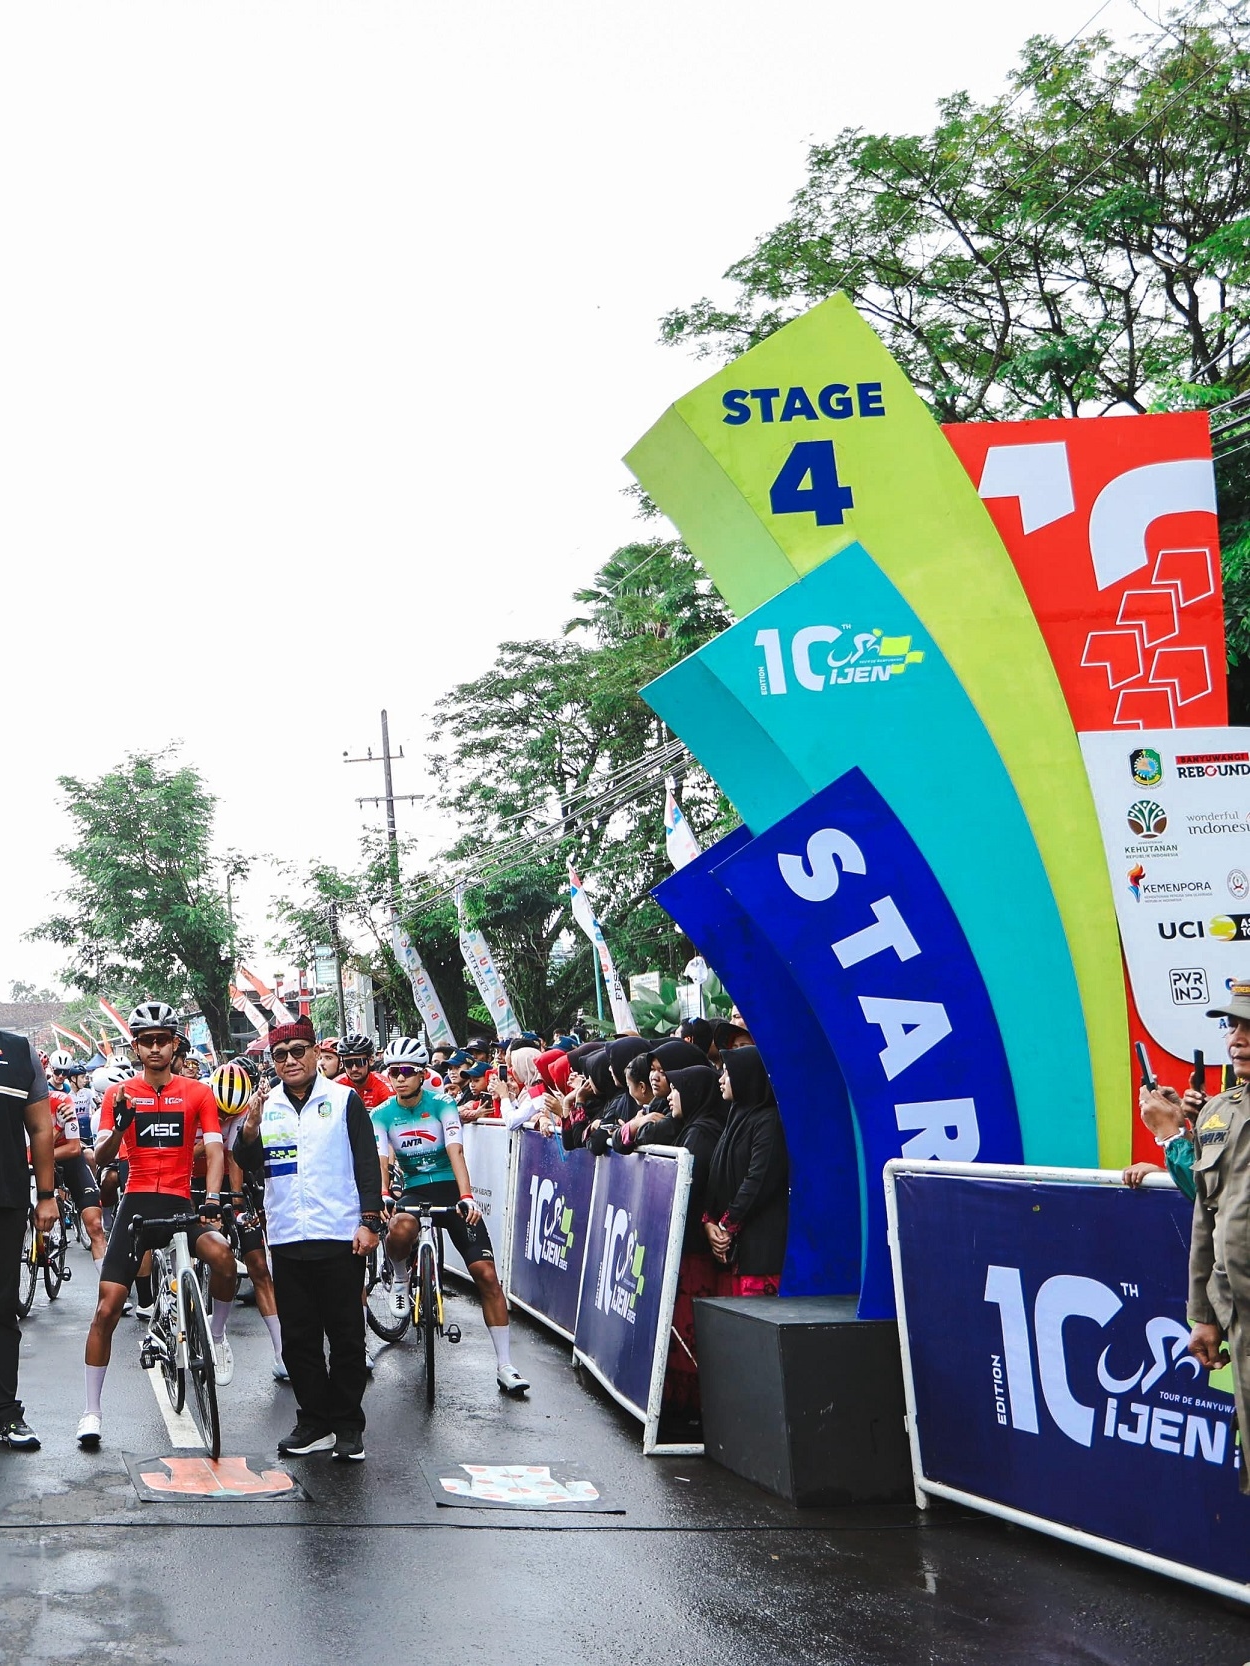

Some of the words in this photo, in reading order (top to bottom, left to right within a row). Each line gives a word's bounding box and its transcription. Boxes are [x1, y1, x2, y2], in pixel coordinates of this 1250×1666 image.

[722, 382, 886, 425] STAGE
[769, 440, 854, 526] 4
[757, 666, 768, 695] EDITION
[1181, 752, 1245, 763] BANYUWANGI
[1186, 811, 1240, 822] wonderful
[1124, 844, 1178, 853] KEHUTANAN
[1143, 882, 1211, 894] KEMENPORA
[1158, 921, 1205, 940] UCI
[1172, 972, 1204, 986] PVR
[777, 828, 981, 1163] STAR
[401, 1138, 423, 1148] ANTA
[1120, 1283, 1139, 1298] TH
[990, 1354, 1007, 1426] EDITION
[1159, 1391, 1180, 1402] TOUR
[1182, 1396, 1192, 1405] DE
